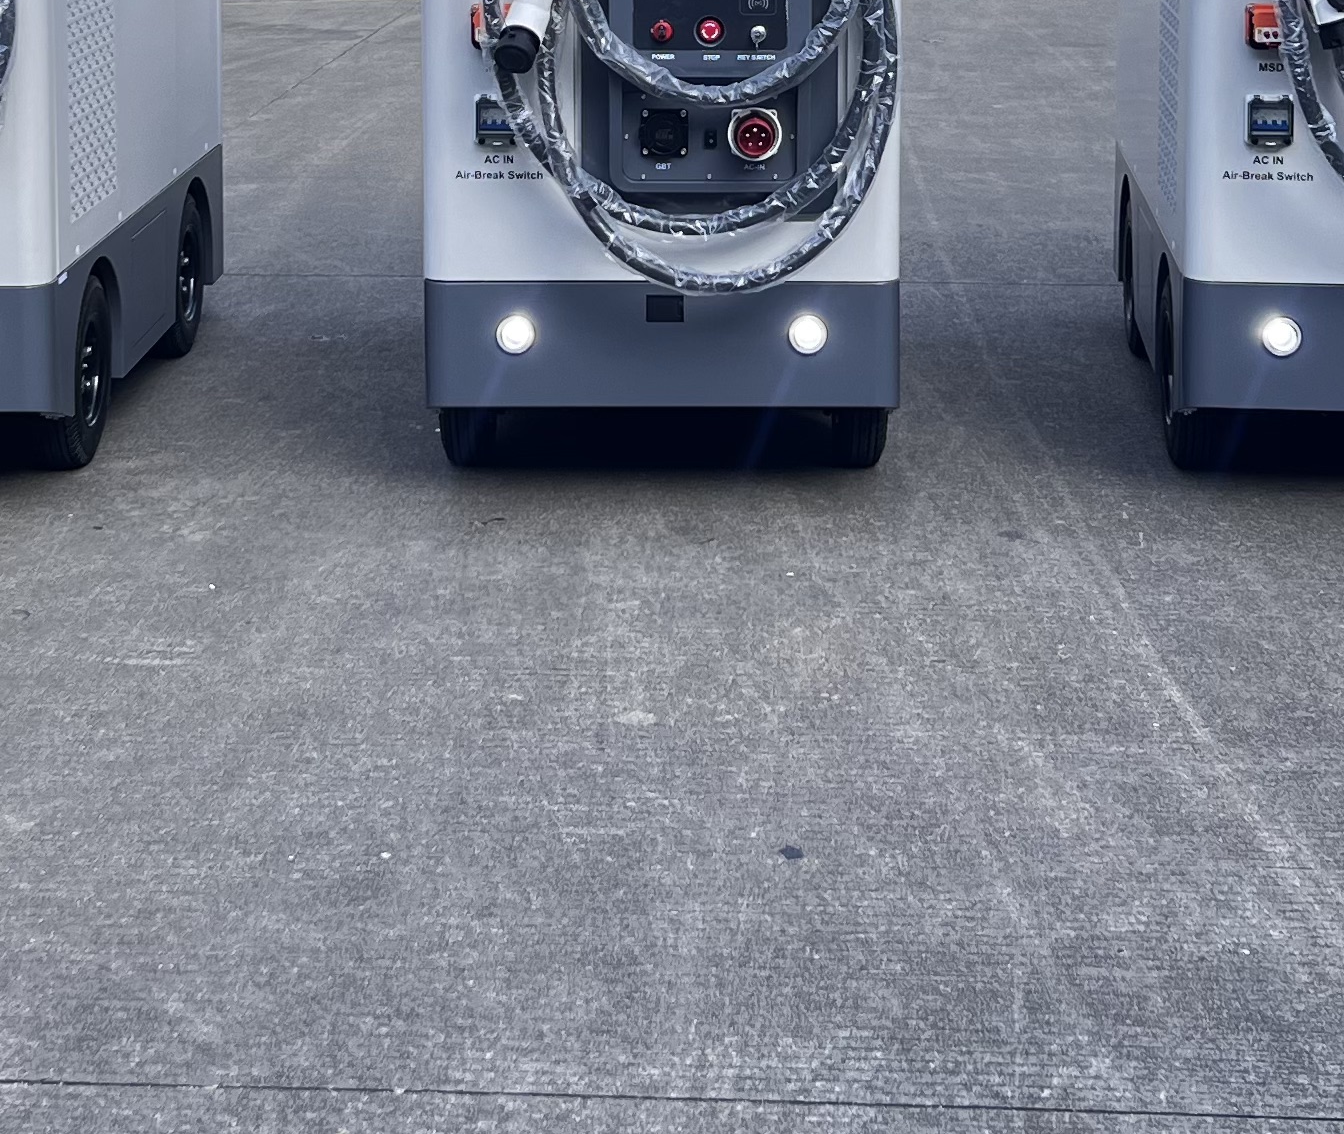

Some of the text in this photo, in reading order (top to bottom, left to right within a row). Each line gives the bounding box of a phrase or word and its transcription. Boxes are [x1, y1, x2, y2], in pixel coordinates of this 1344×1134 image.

[651, 53, 676, 61] POWER
[1258, 62, 1284, 72] MSD
[484, 154, 515, 164] AC IN
[1252, 155, 1284, 165] AC IN
[655, 162, 672, 170] GBT
[455, 170, 544, 180] Air-Break Switch
[1222, 170, 1314, 182] Air-Break Switch
